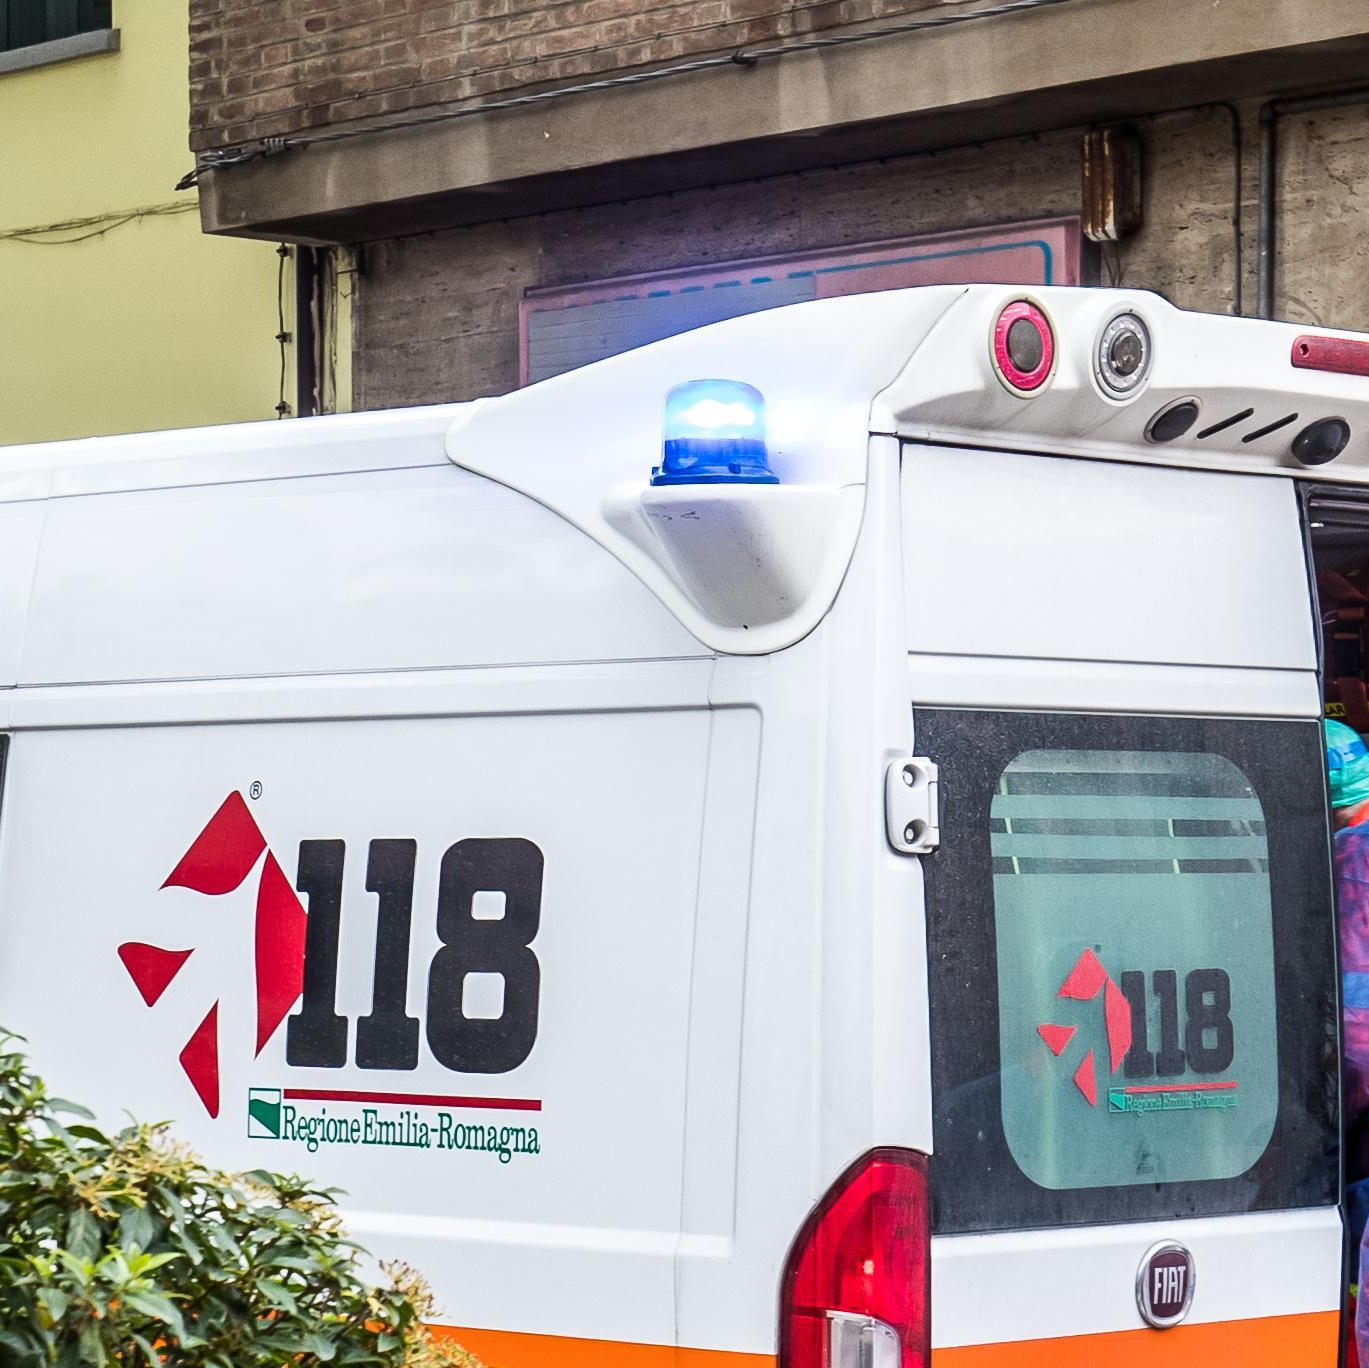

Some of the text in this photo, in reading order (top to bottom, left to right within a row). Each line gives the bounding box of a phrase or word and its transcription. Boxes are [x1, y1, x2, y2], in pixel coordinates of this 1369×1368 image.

[286, 838, 544, 1074] 118
[1121, 968, 1235, 1079] 118
[1153, 1265, 1187, 1305] FIAT
